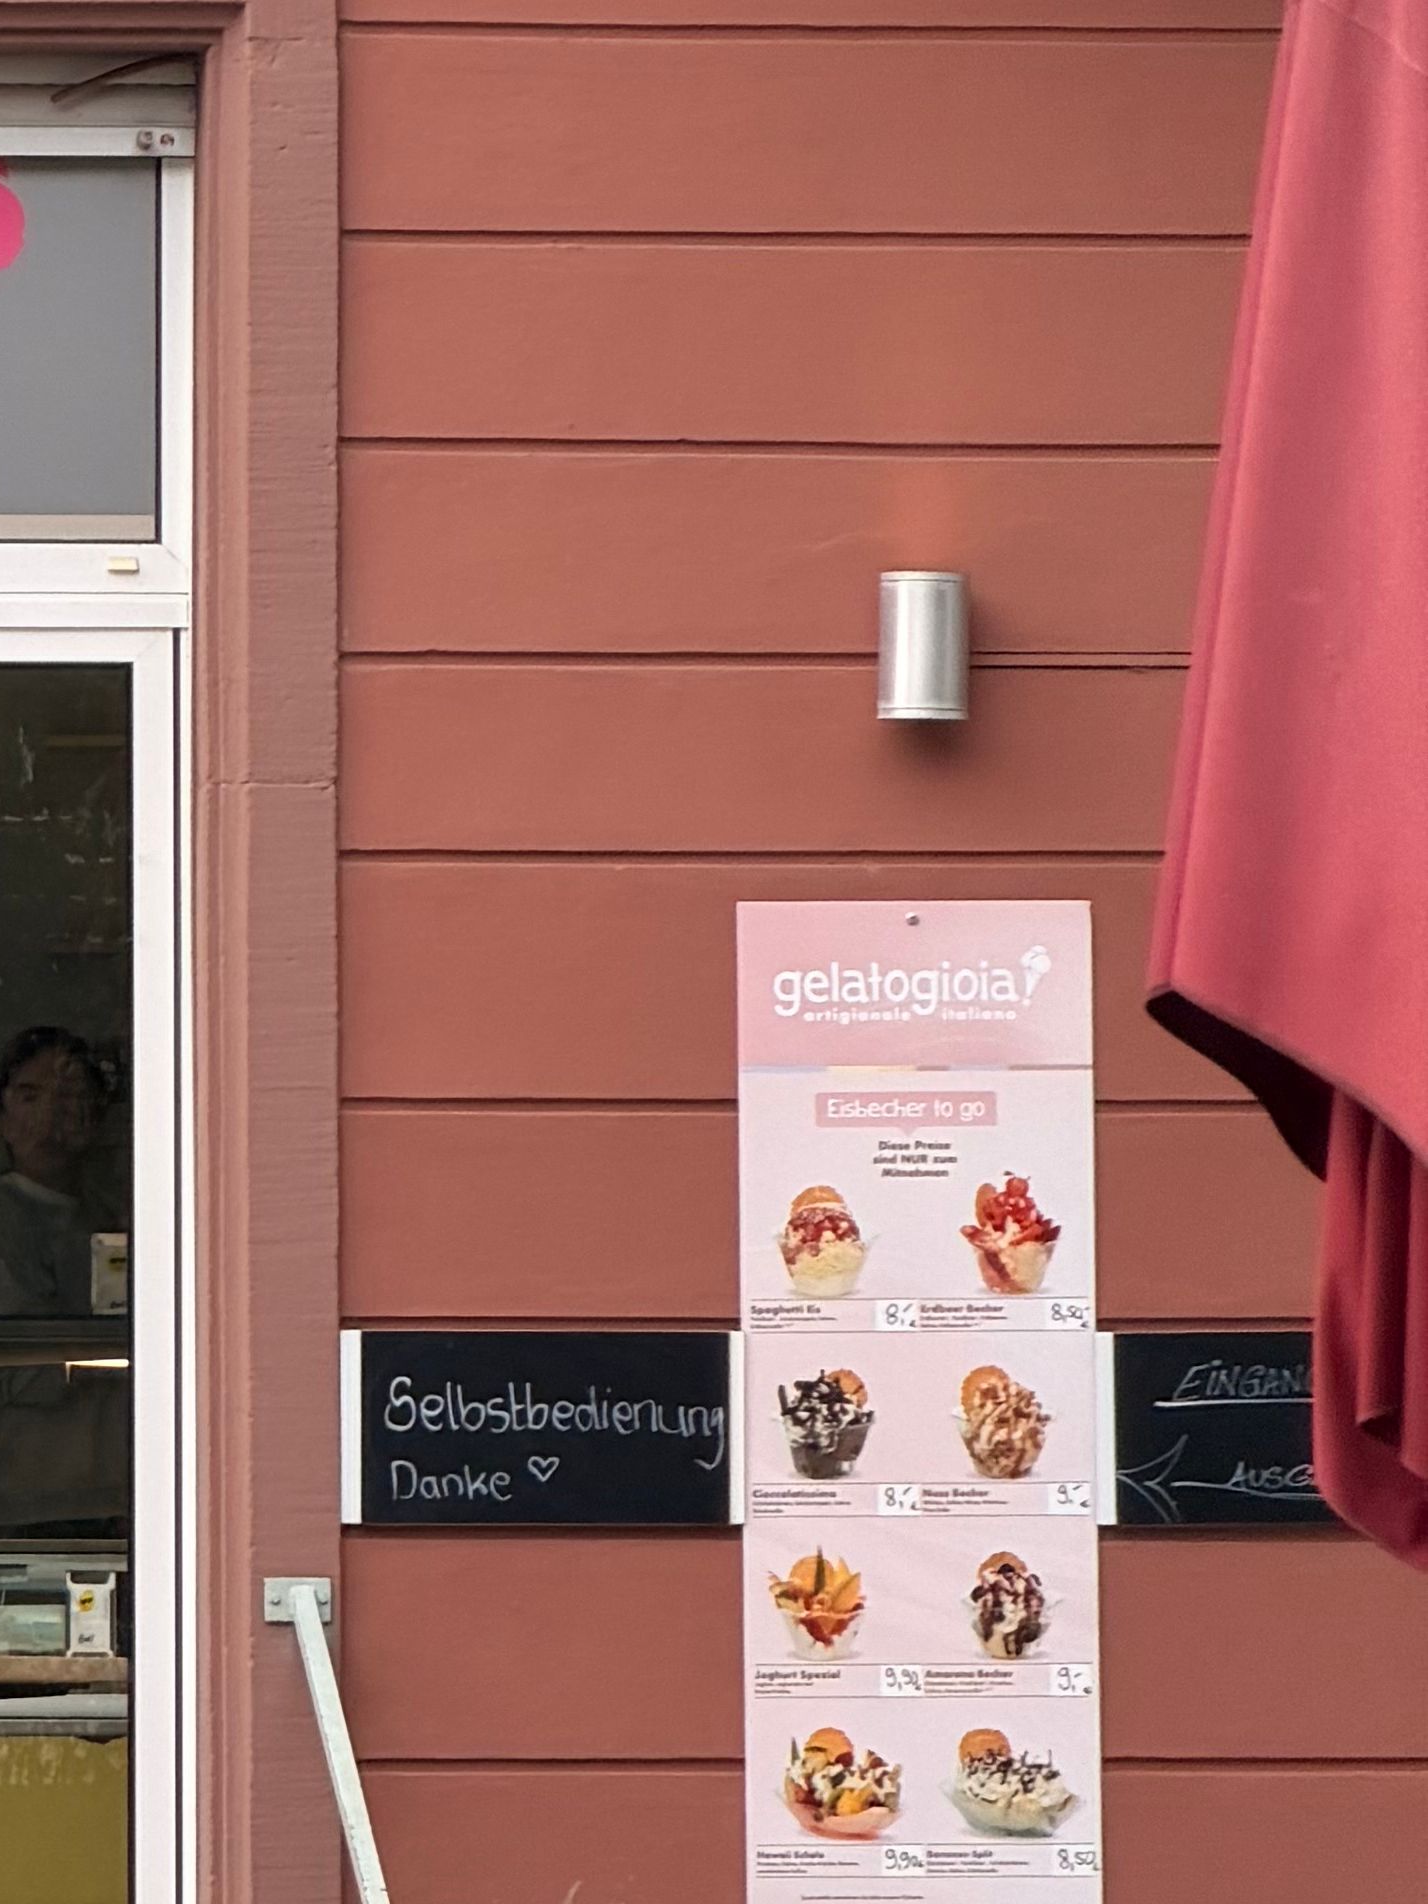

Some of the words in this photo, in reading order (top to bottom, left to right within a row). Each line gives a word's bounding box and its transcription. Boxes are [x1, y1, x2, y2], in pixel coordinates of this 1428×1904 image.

[803, 1007, 912, 1025] artigianale
[942, 1007, 1017, 1021] italiano
[827, 1098, 927, 1118] Eisbecher
[934, 1099, 954, 1118] to
[959, 1101, 986, 1122] go
[877, 1140, 911, 1151] Diese
[914, 1140, 952, 1151] Preise
[900, 1154, 929, 1164] NUR
[384, 1375, 727, 1471] Selbstbedienung
[390, 1459, 513, 1502] Danke
